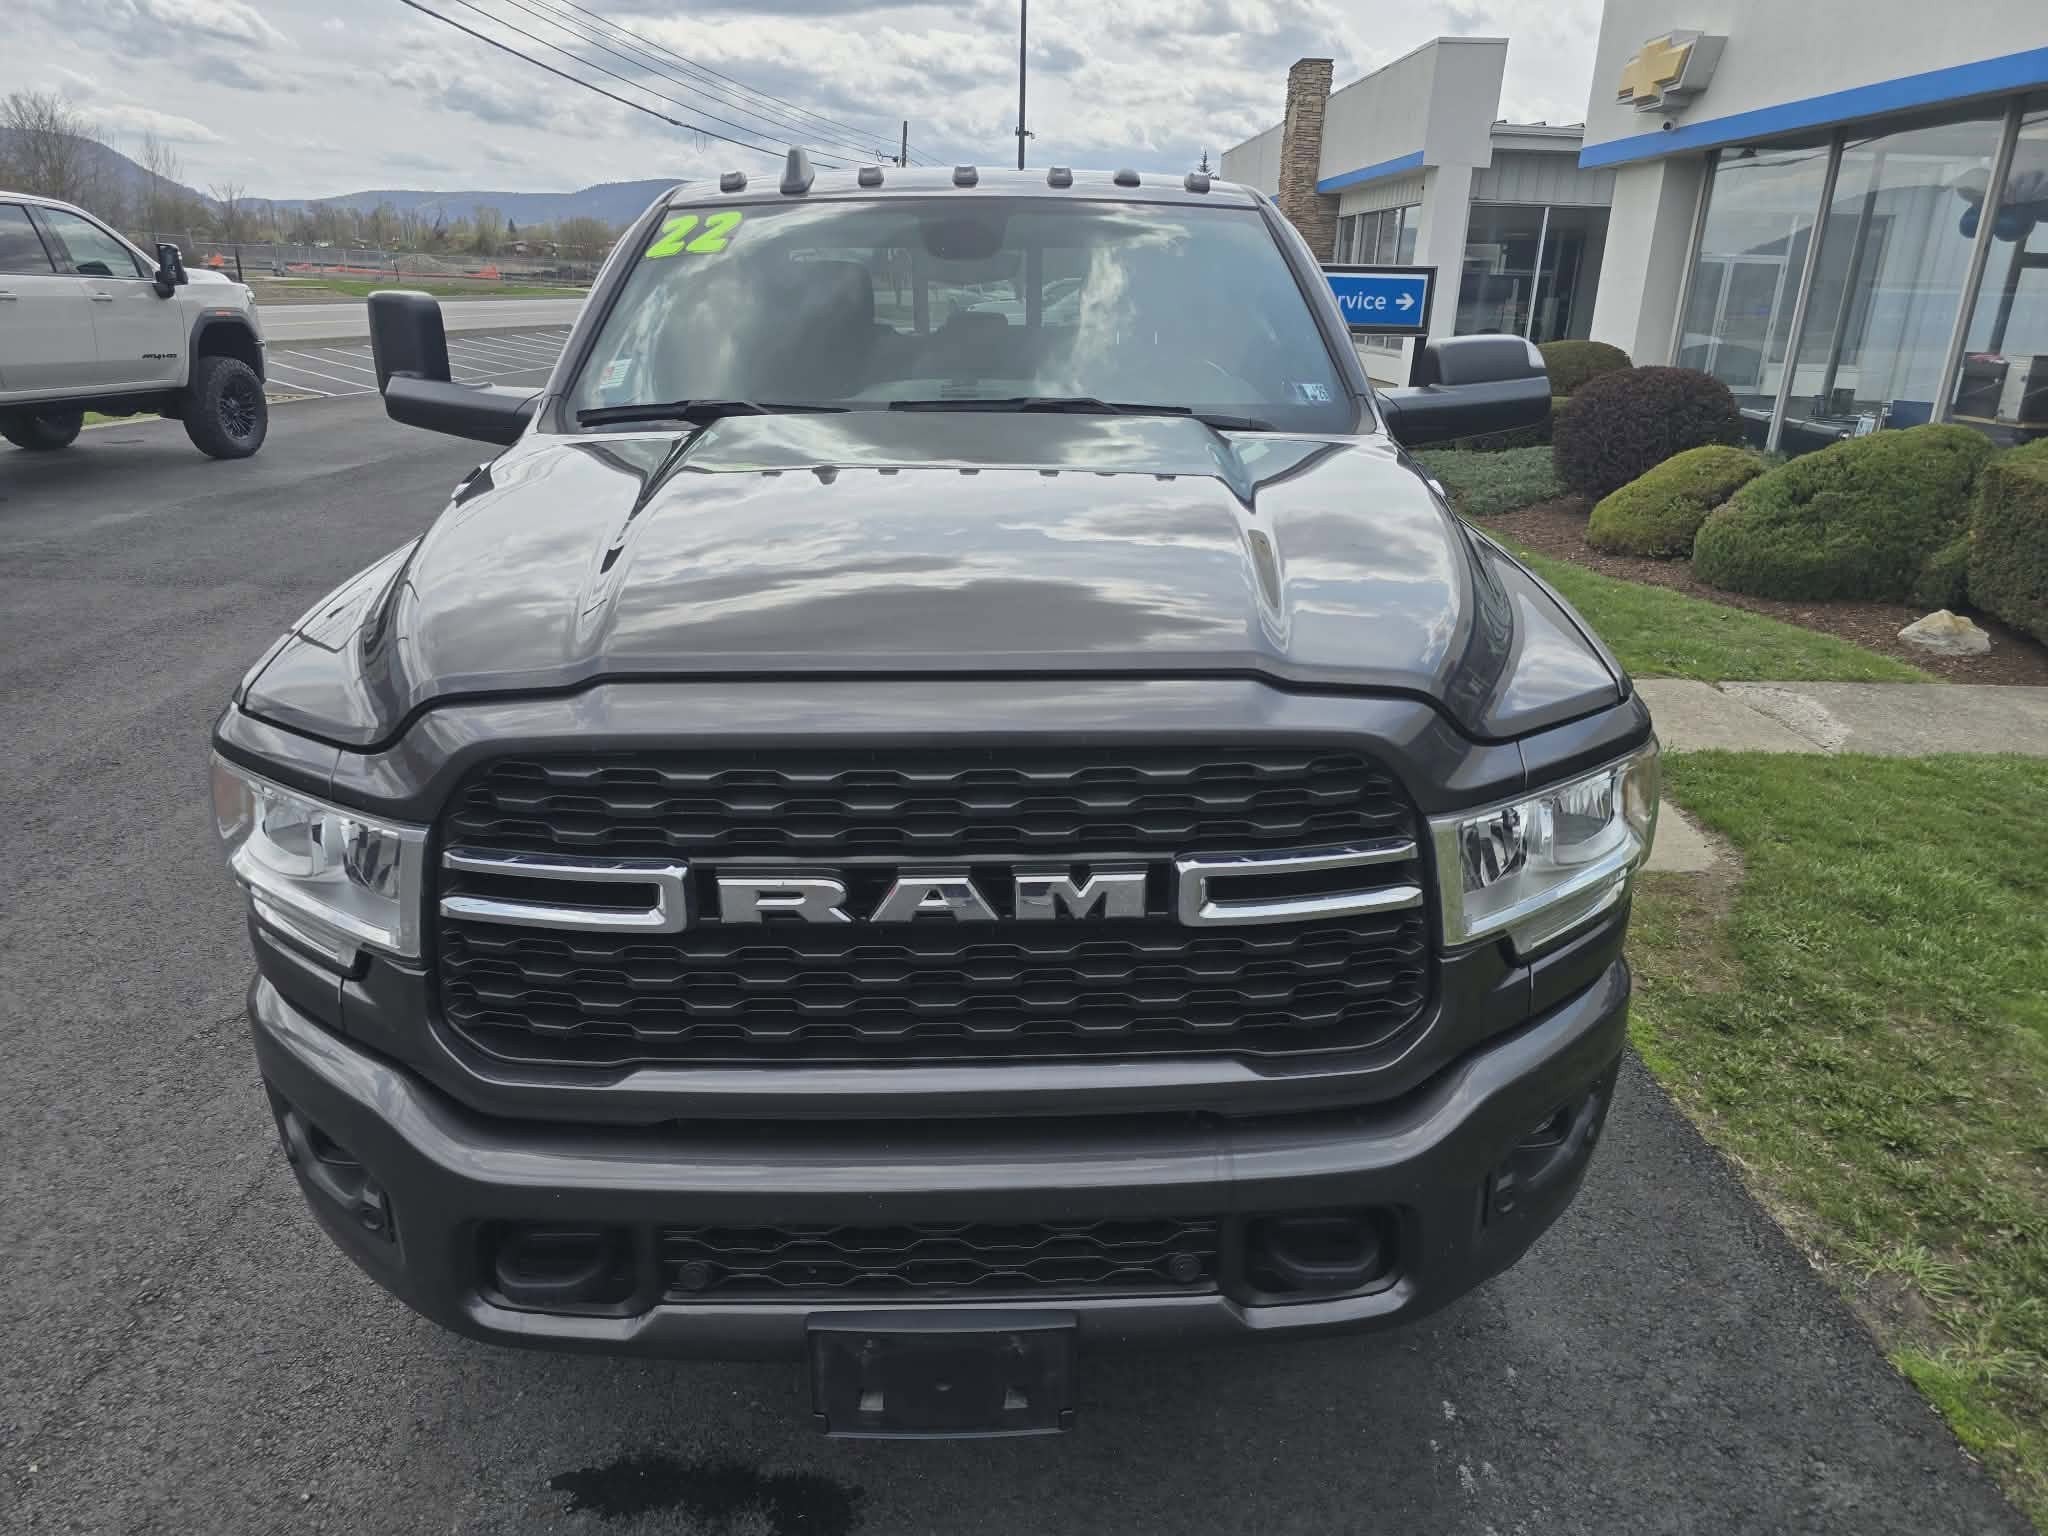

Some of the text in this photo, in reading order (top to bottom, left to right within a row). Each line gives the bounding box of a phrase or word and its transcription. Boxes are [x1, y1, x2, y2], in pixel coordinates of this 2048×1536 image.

[646, 211, 743, 258] 22
[1337, 291, 1387, 310] rvice
[716, 872, 1147, 923] RAM
